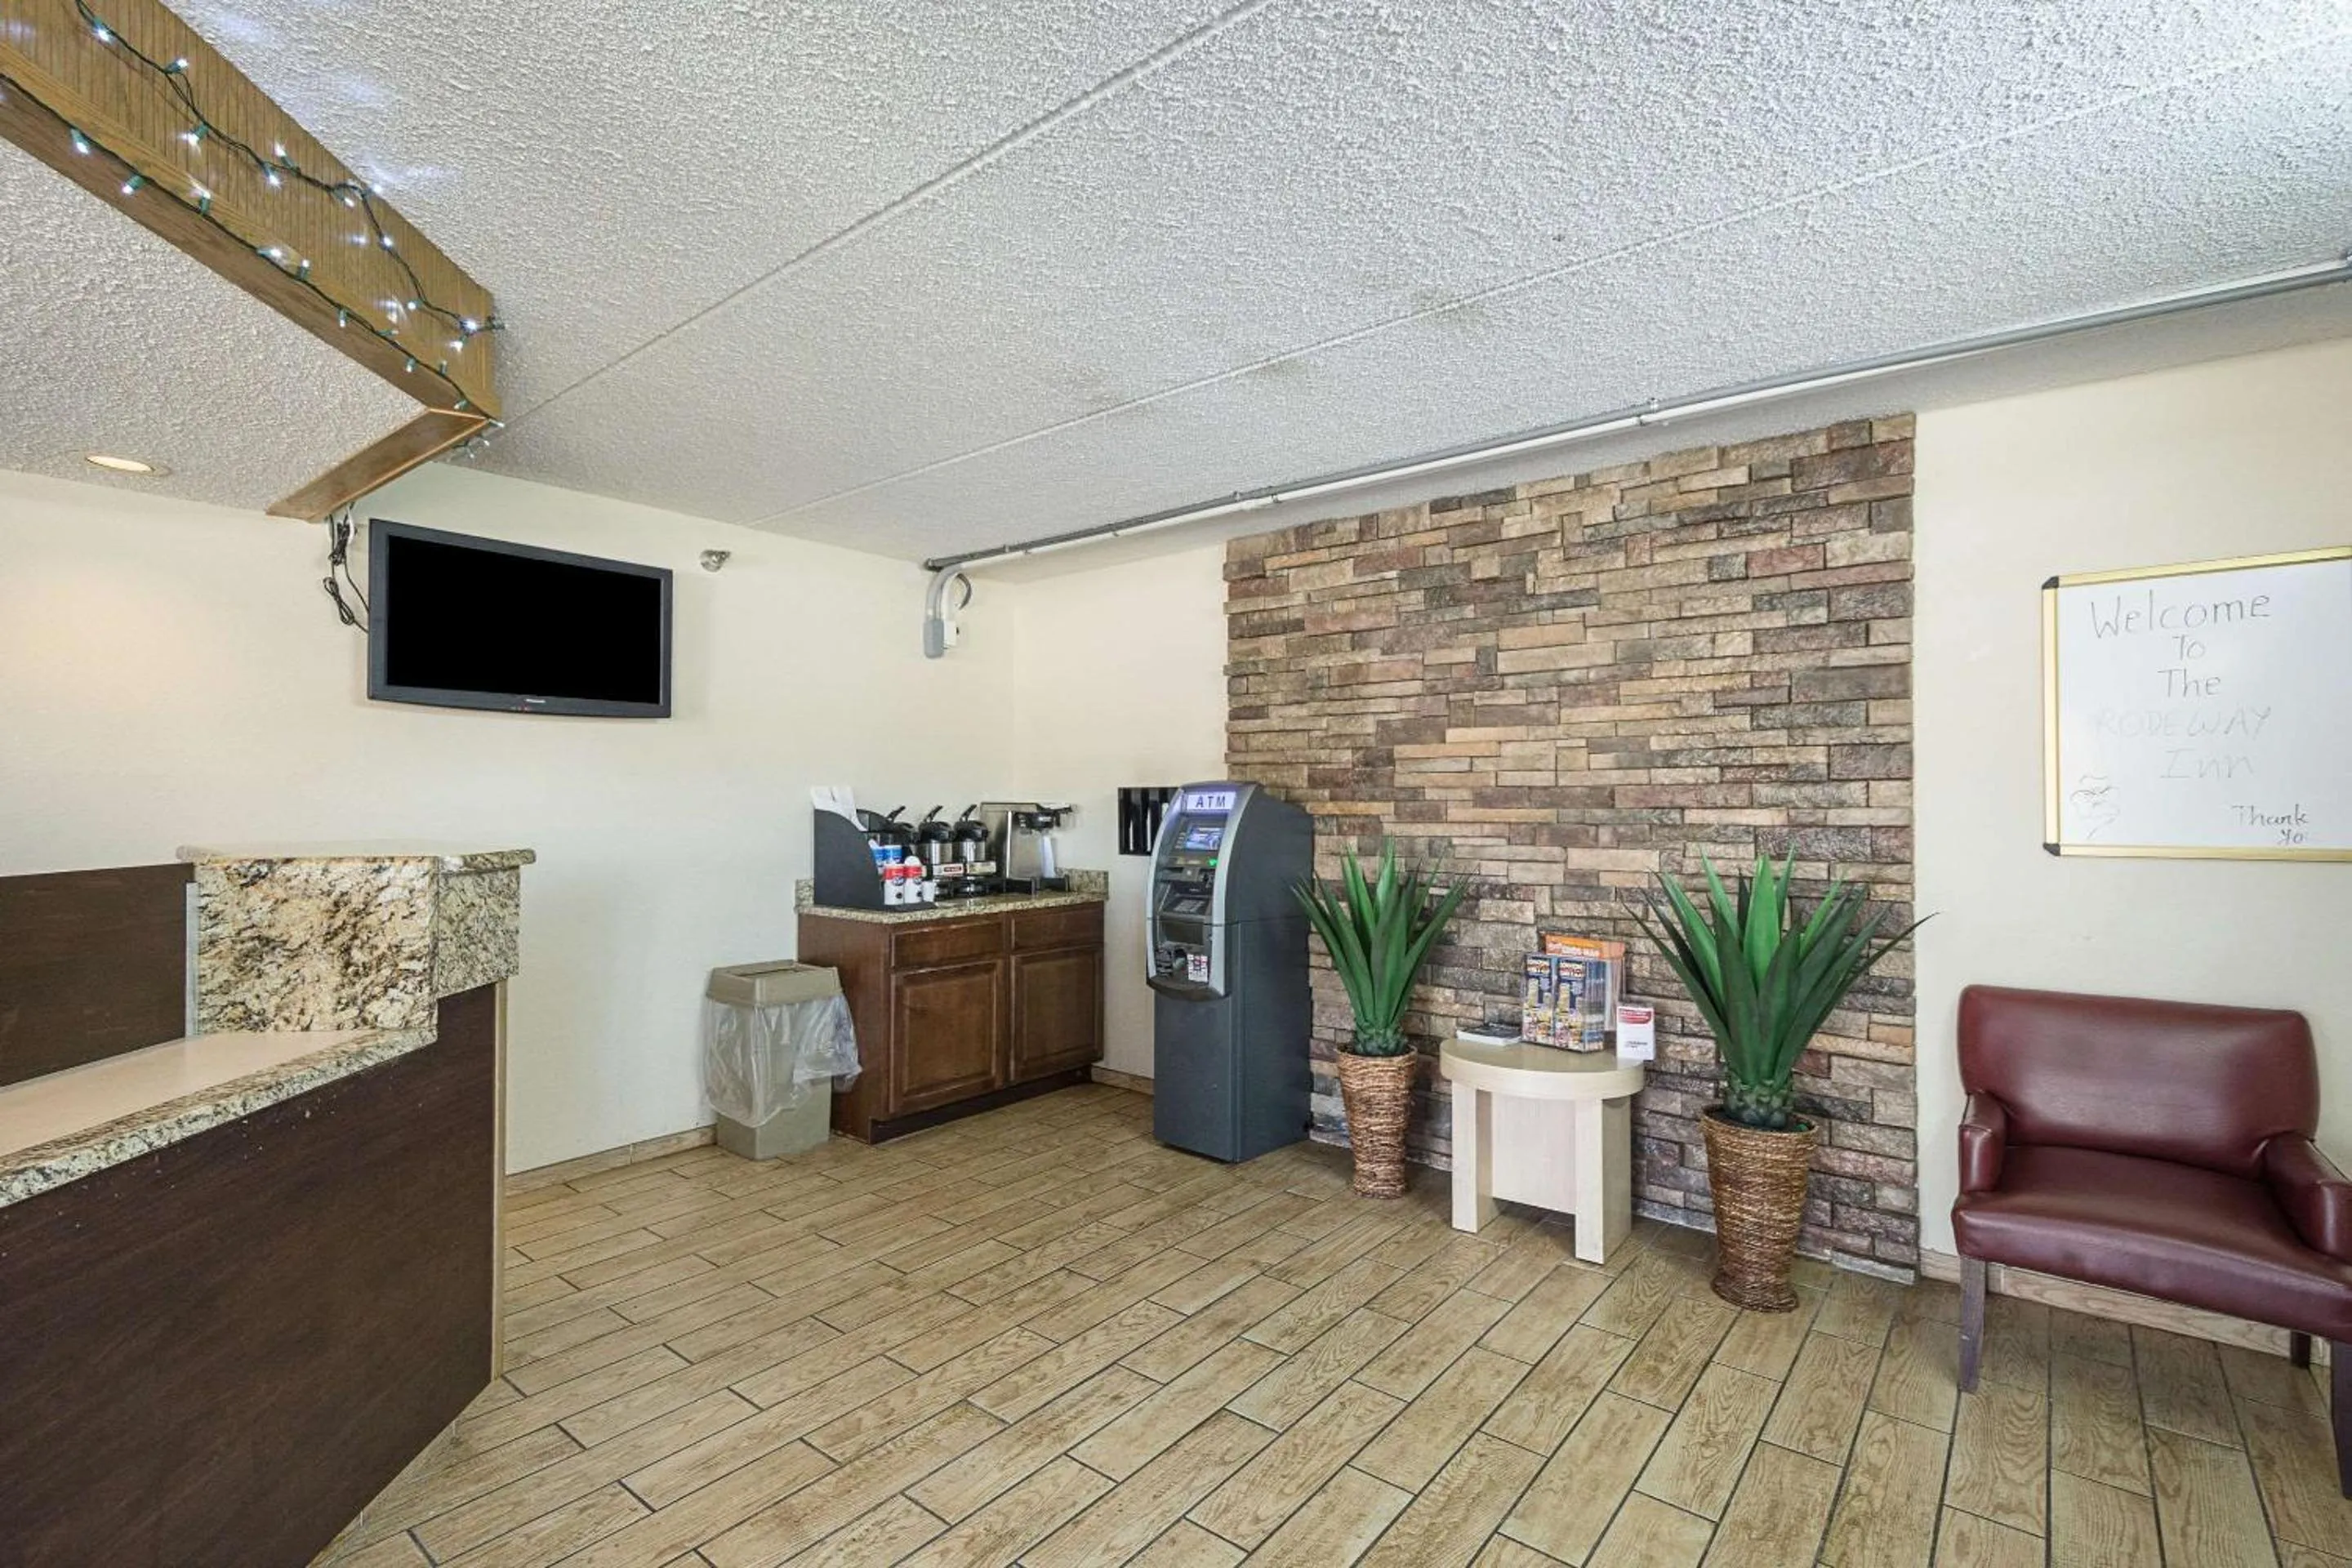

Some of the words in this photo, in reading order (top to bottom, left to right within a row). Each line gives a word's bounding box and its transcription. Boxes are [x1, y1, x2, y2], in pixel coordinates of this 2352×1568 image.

[2091, 589, 2271, 639] Welcome
[2172, 634, 2207, 662] To
[2157, 668, 2222, 698] The
[2096, 706, 2272, 740] RODEWAY
[2159, 747, 2254, 779] Inn
[1195, 795, 1226, 808] ATM
[2230, 804, 2310, 827] Thank
